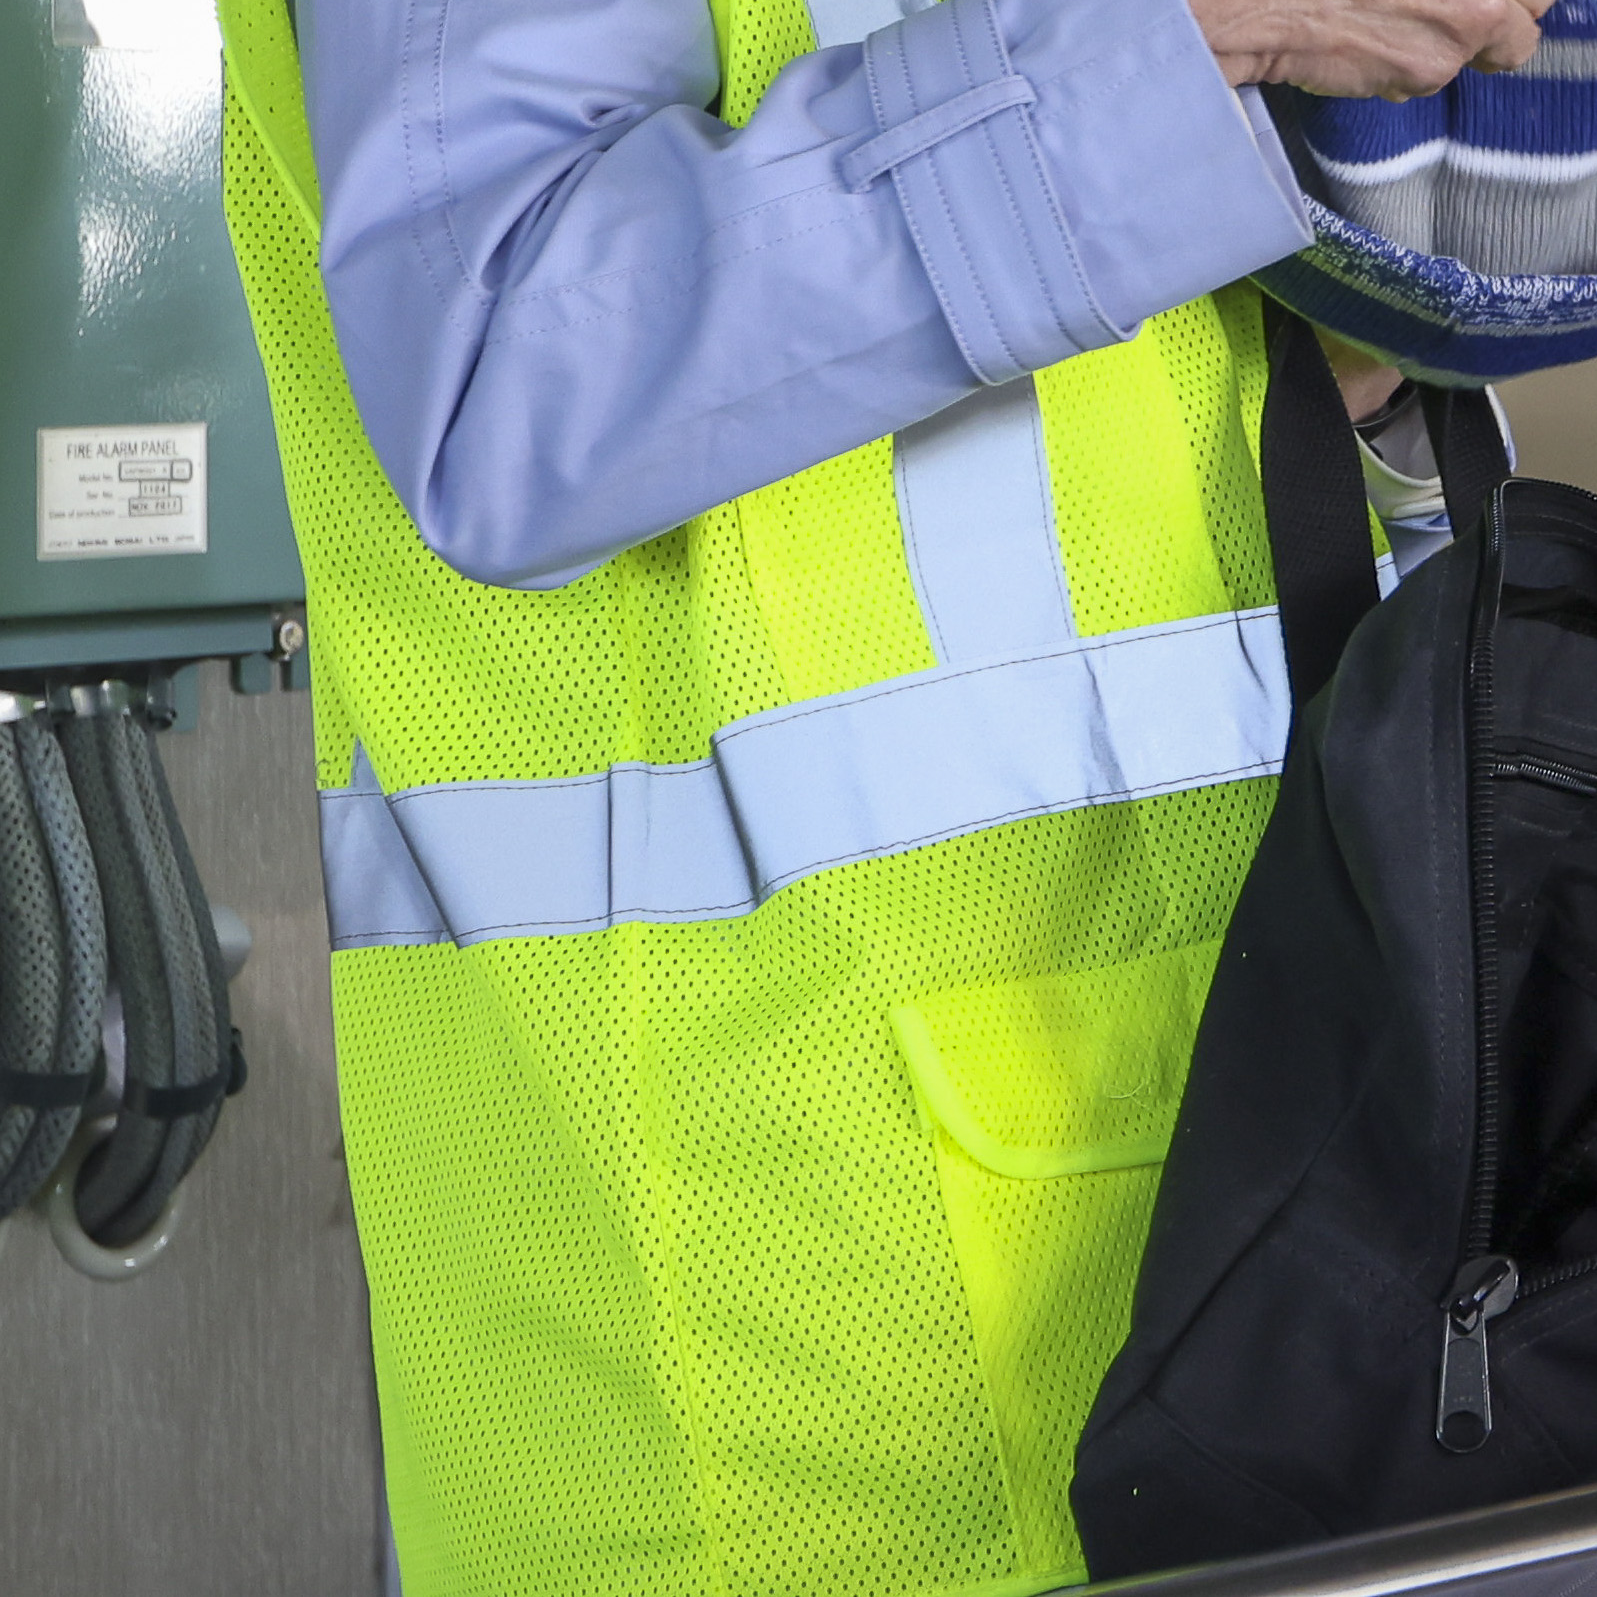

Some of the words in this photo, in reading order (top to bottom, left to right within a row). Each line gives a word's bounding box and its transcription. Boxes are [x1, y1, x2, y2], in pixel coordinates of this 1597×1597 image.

[66, 441, 92, 460] FIRE
[97, 439, 138, 458] ALARM
[141, 437, 178, 456] PANEL
